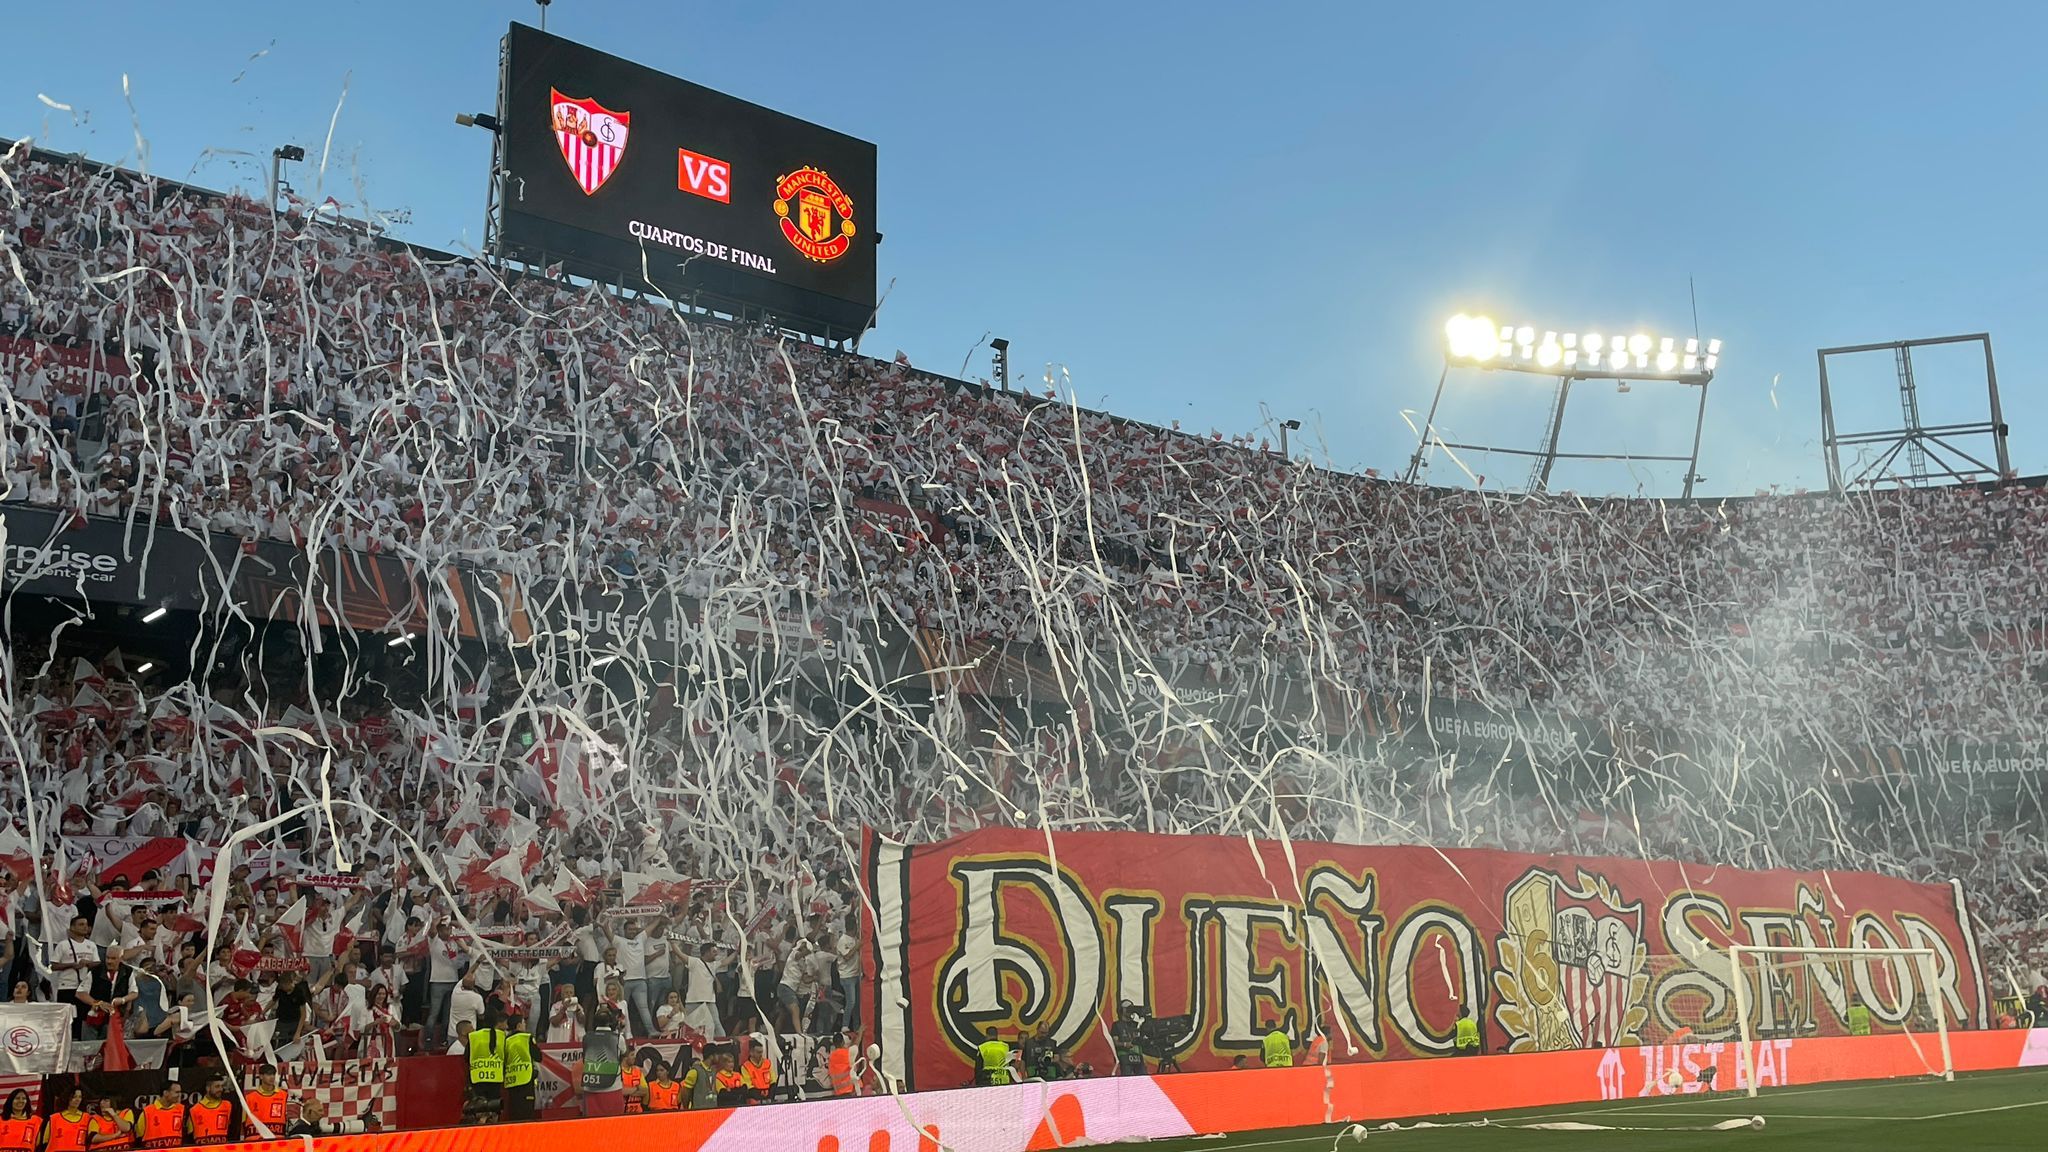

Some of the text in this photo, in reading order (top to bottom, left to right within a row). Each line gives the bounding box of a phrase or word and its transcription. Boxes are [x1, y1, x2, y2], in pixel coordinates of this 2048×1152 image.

[683, 156, 728, 197] VS
[783, 173, 847, 213] MANCHESTER
[629, 221, 777, 274] CUARTOS DE FINAL
[793, 233, 838, 257] UNITED
[583, 608, 658, 641] UEFA
[1434, 716, 1473, 737] UEFA
[1474, 721, 1524, 742] EUROPA
[304, 875, 361, 885] CAMPEON
[939, 859, 1487, 1057] DUEÑO
[1653, 882, 1969, 1036] SEÑOR
[478, 1071, 496, 1080] 015
[583, 1073, 601, 1084] 051
[587, 1062, 601, 1073] TV
[1638, 1043, 1724, 1098] JUST
